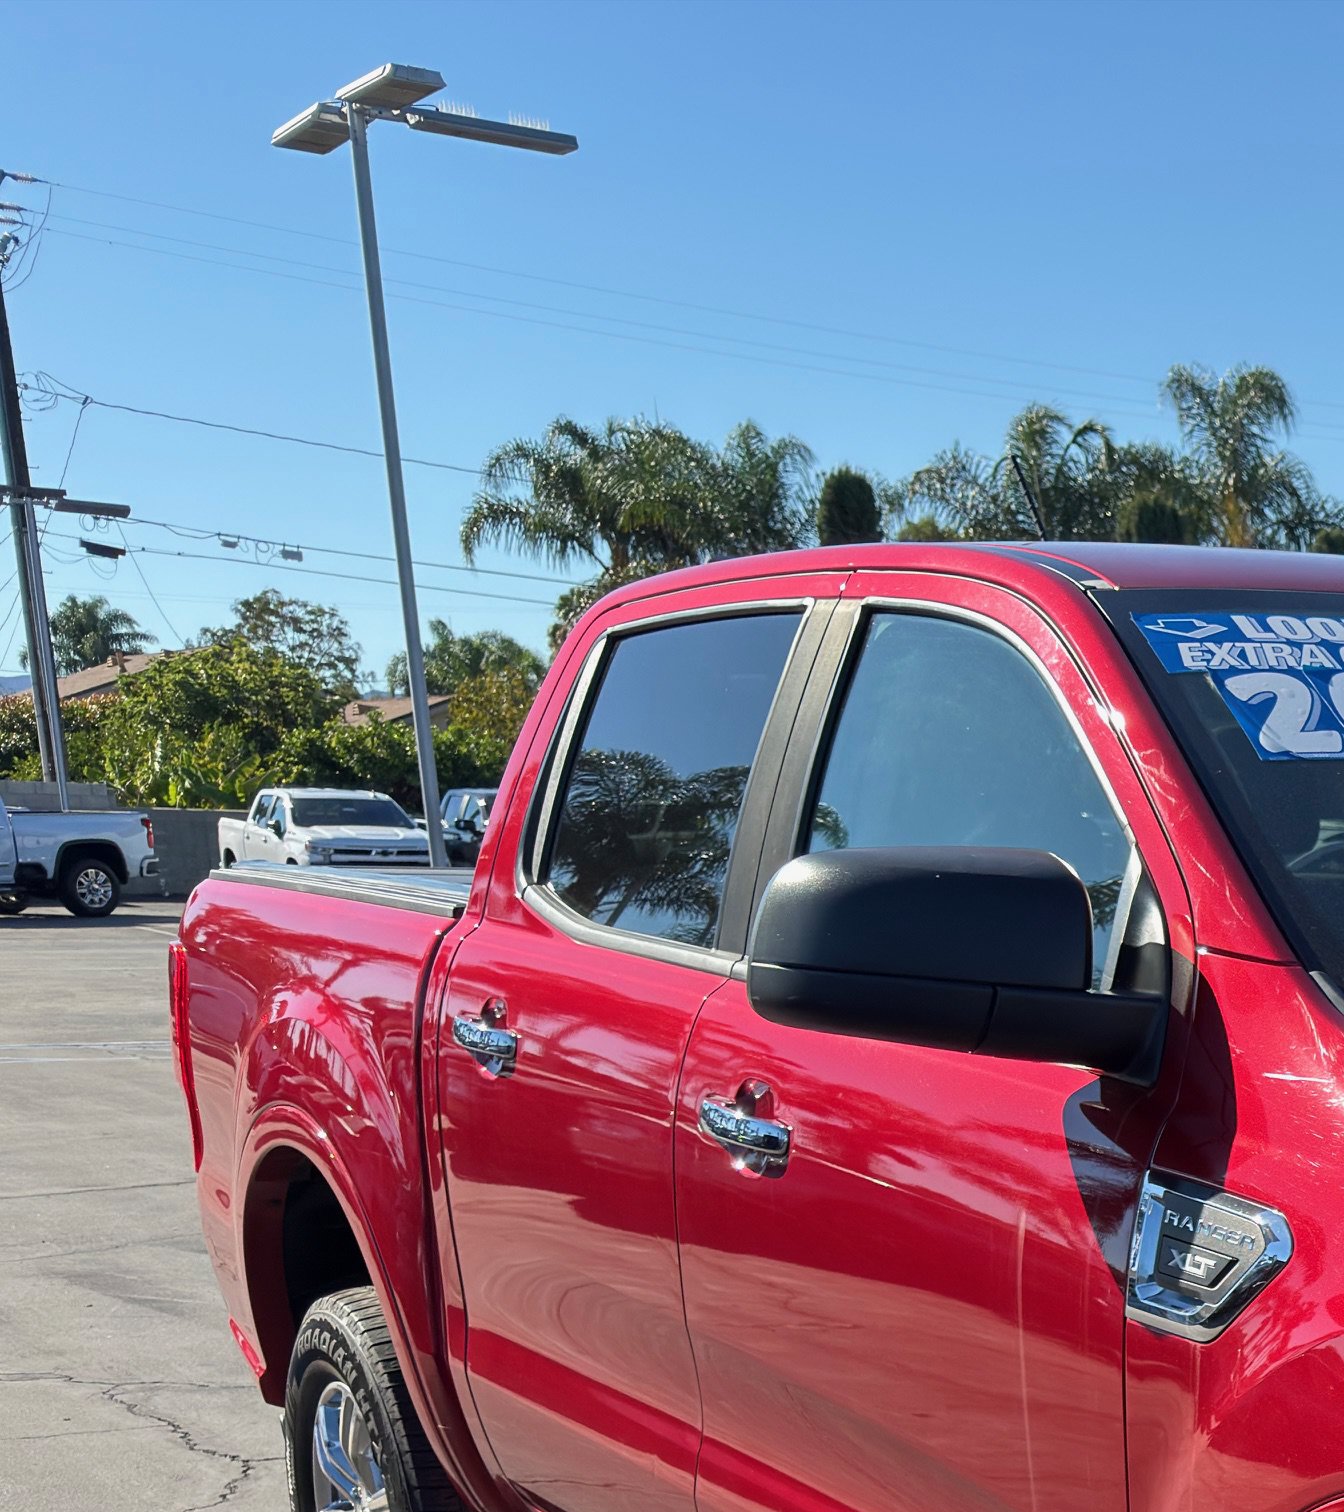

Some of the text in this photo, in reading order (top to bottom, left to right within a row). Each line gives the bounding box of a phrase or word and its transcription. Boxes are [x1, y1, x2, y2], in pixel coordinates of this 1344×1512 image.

[1177, 641, 1338, 672] EXTRA
[1164, 1208, 1256, 1250] RANGER
[1168, 1249, 1217, 1278] XLT
